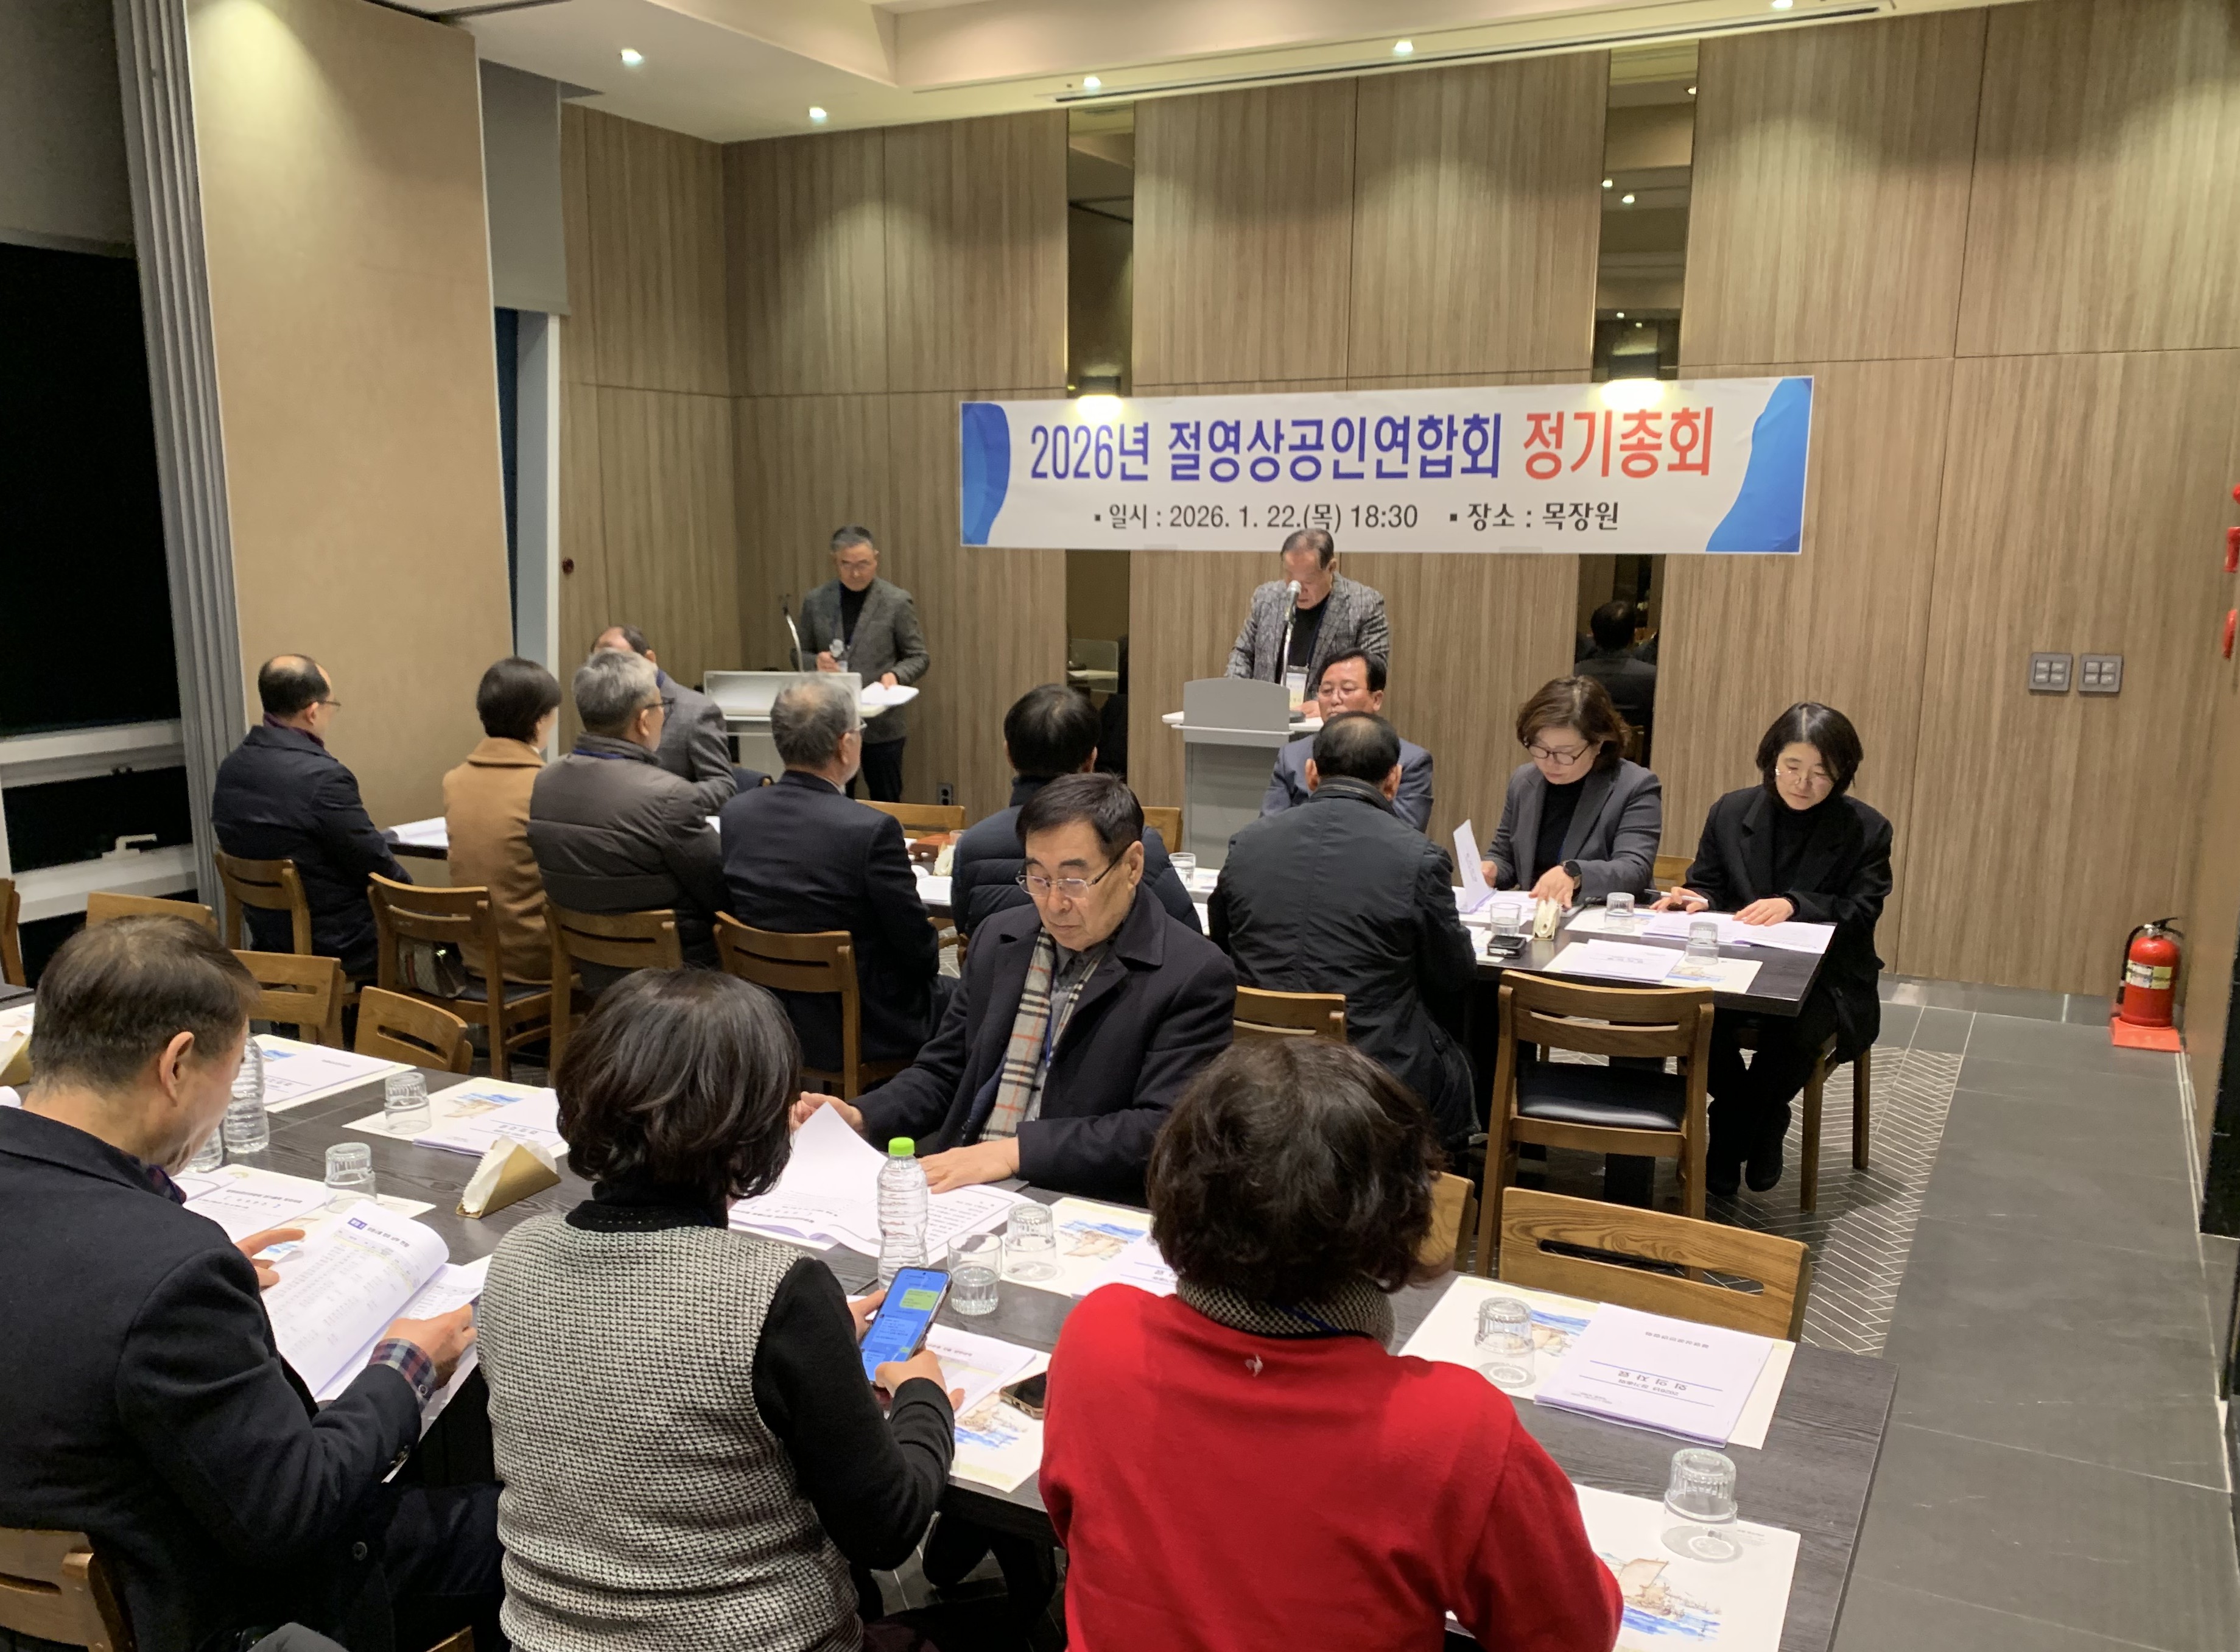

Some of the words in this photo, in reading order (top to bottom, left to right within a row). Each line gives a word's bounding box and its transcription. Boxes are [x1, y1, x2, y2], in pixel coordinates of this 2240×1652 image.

[1031, 421, 1149, 481] 2026년
[1168, 412, 1502, 483] 절영상공인연합회
[1523, 407, 1714, 480] 정기총회
[1109, 504, 1147, 530] 일시
[1170, 505, 1230, 528] 2026.
[1239, 505, 1258, 528] 1.
[1267, 504, 1341, 533] 22.(목)
[1350, 504, 1418, 529] 18:30
[1467, 502, 1515, 531] 장소
[1542, 501, 1619, 531] 목장원
